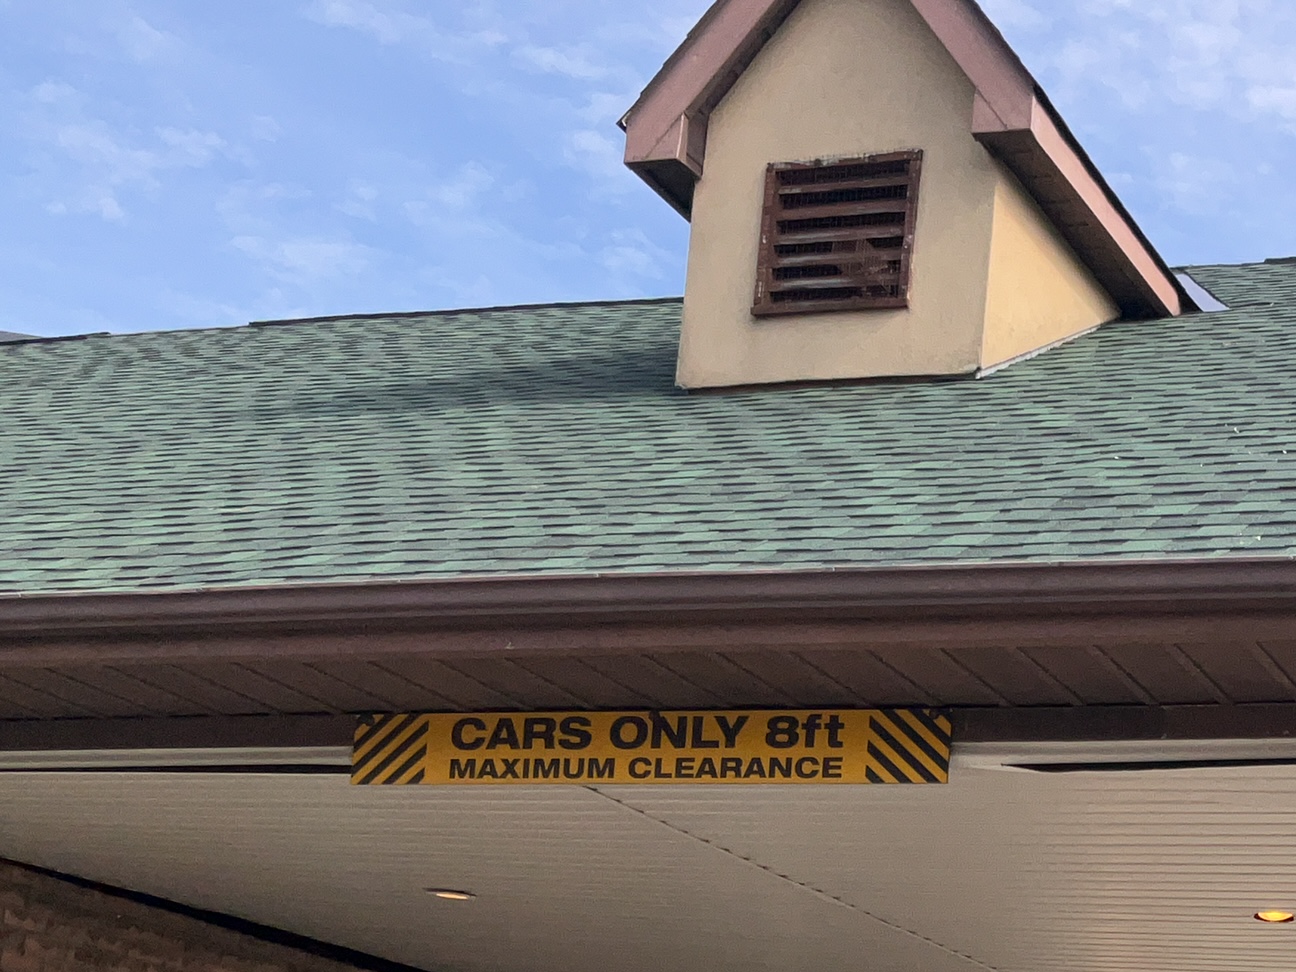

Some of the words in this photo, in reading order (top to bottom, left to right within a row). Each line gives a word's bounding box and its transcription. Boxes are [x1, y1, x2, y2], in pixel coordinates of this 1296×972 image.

[451, 716, 593, 750] CARS
[609, 714, 749, 750] ONLY
[765, 713, 845, 749] 8ft
[449, 757, 616, 780] MAXIMUM
[628, 756, 843, 779] CLEARANCE
